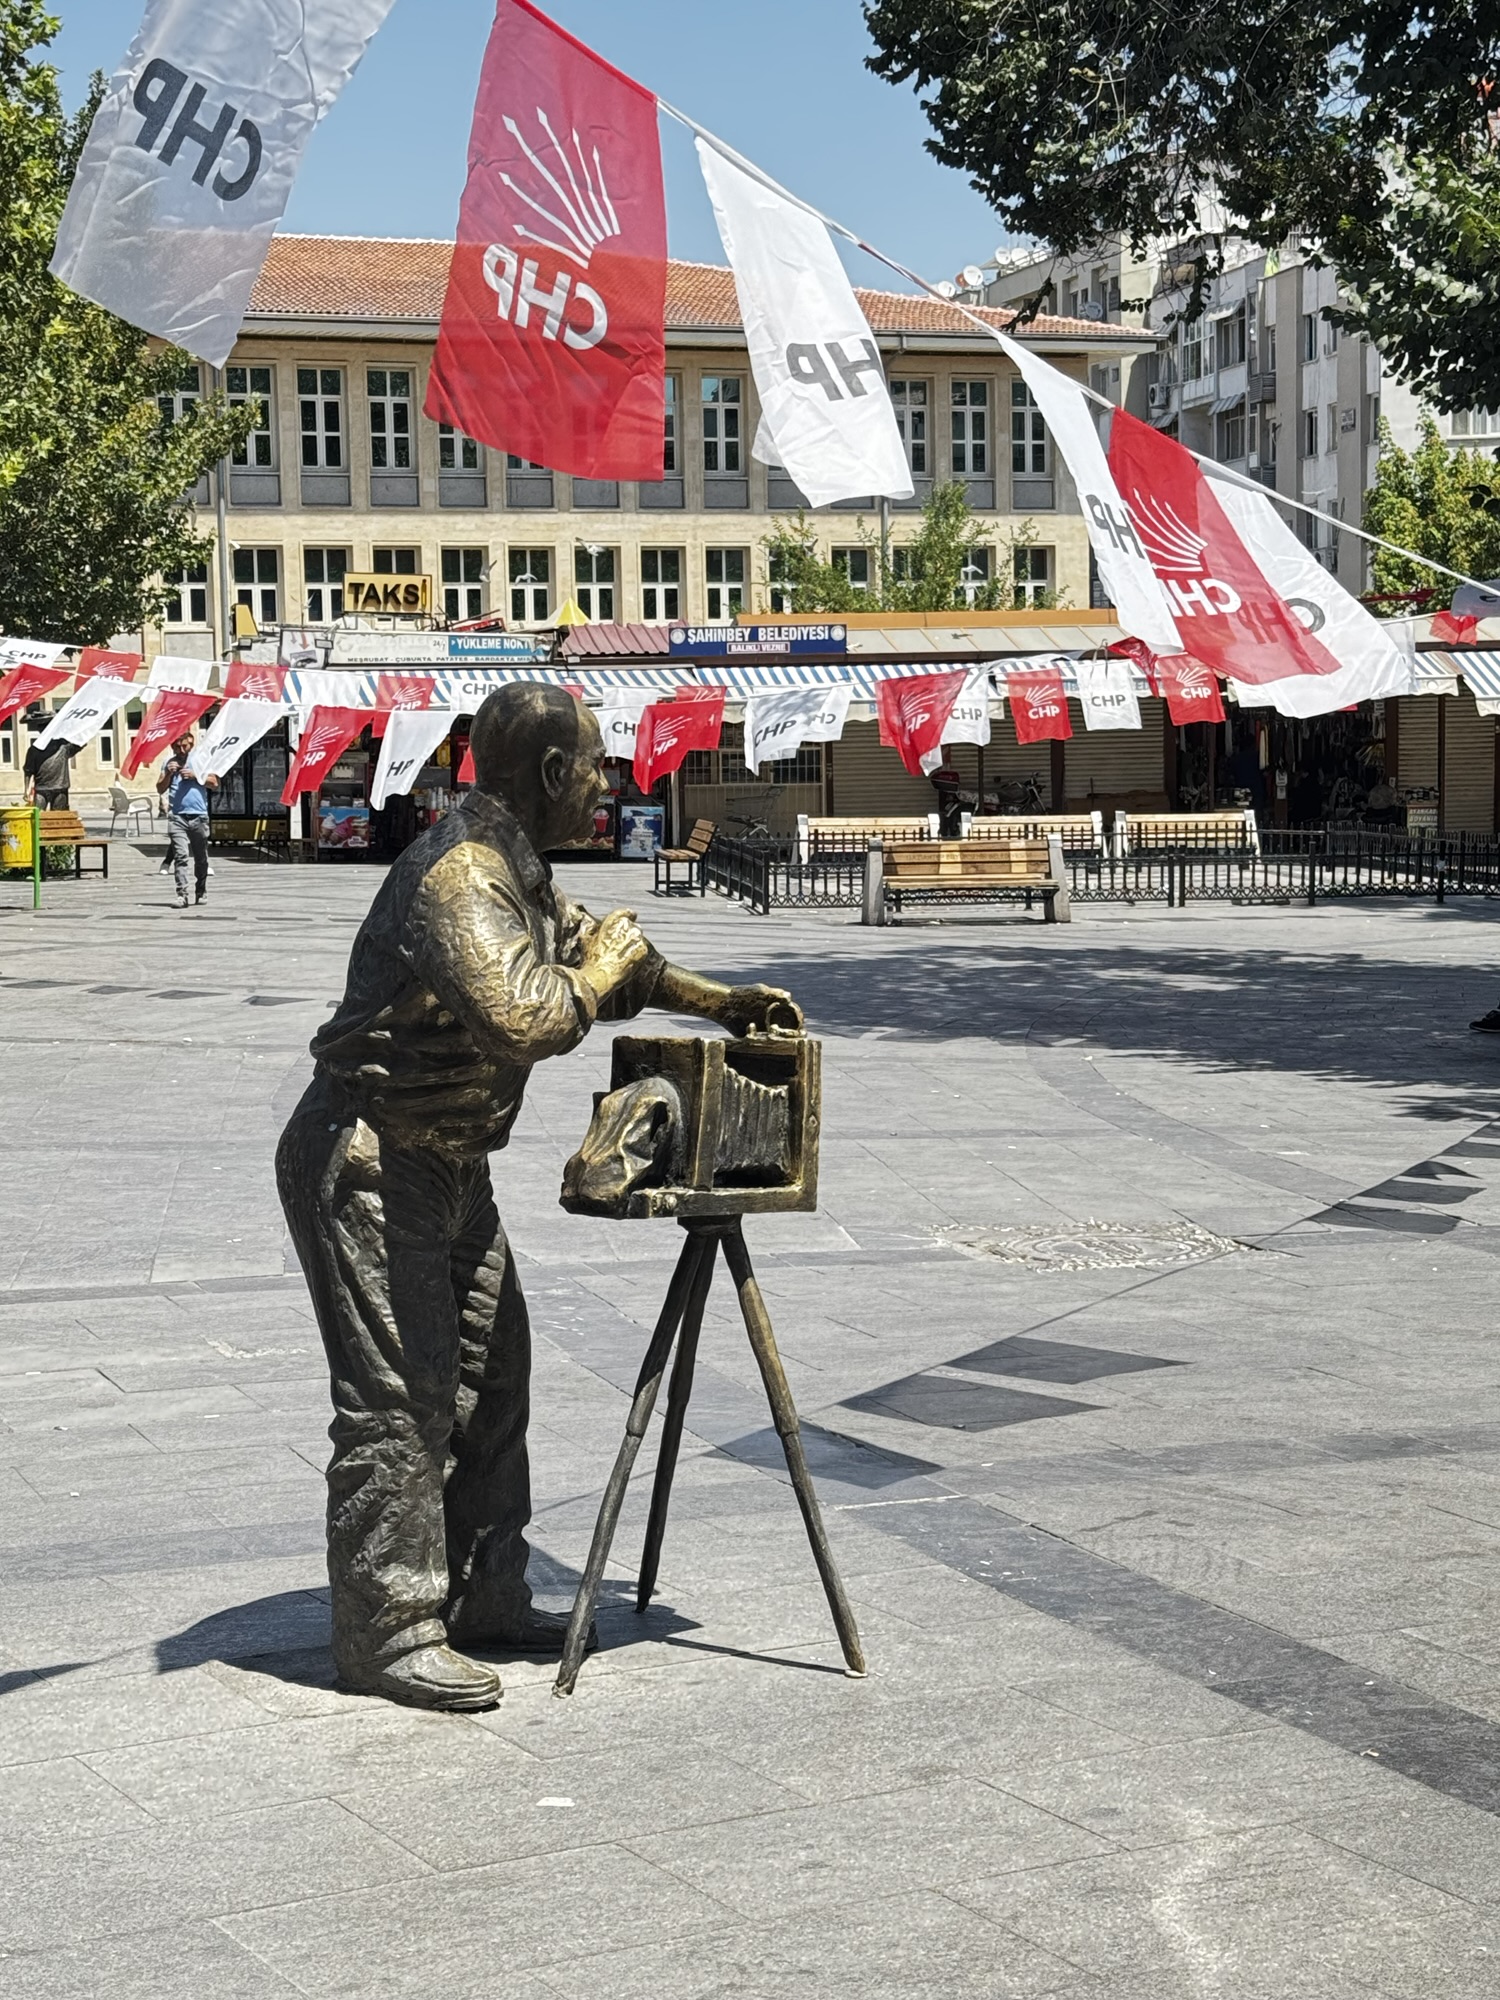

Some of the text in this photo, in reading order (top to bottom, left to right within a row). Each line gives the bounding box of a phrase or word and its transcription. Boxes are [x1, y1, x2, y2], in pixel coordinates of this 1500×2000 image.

[687, 625, 829, 644] ŞAHİNBEY BELEDİYESİ
[456, 637, 502, 649] YÜKLEME
[8, 650, 47, 659] CHP
[1091, 694, 1126, 707] CHP
[1180, 687, 1212, 700] CHP
[1, 698, 20, 710] HP
[950, 708, 982, 720] CHP
[1028, 705, 1060, 719] CHP
[612, 721, 636, 736] CH
[905, 713, 930, 733] HP
[142, 729, 168, 743] HP
[754, 719, 797, 748] CHP
[650, 738, 678, 759] HP
[386, 759, 414, 777] HP
